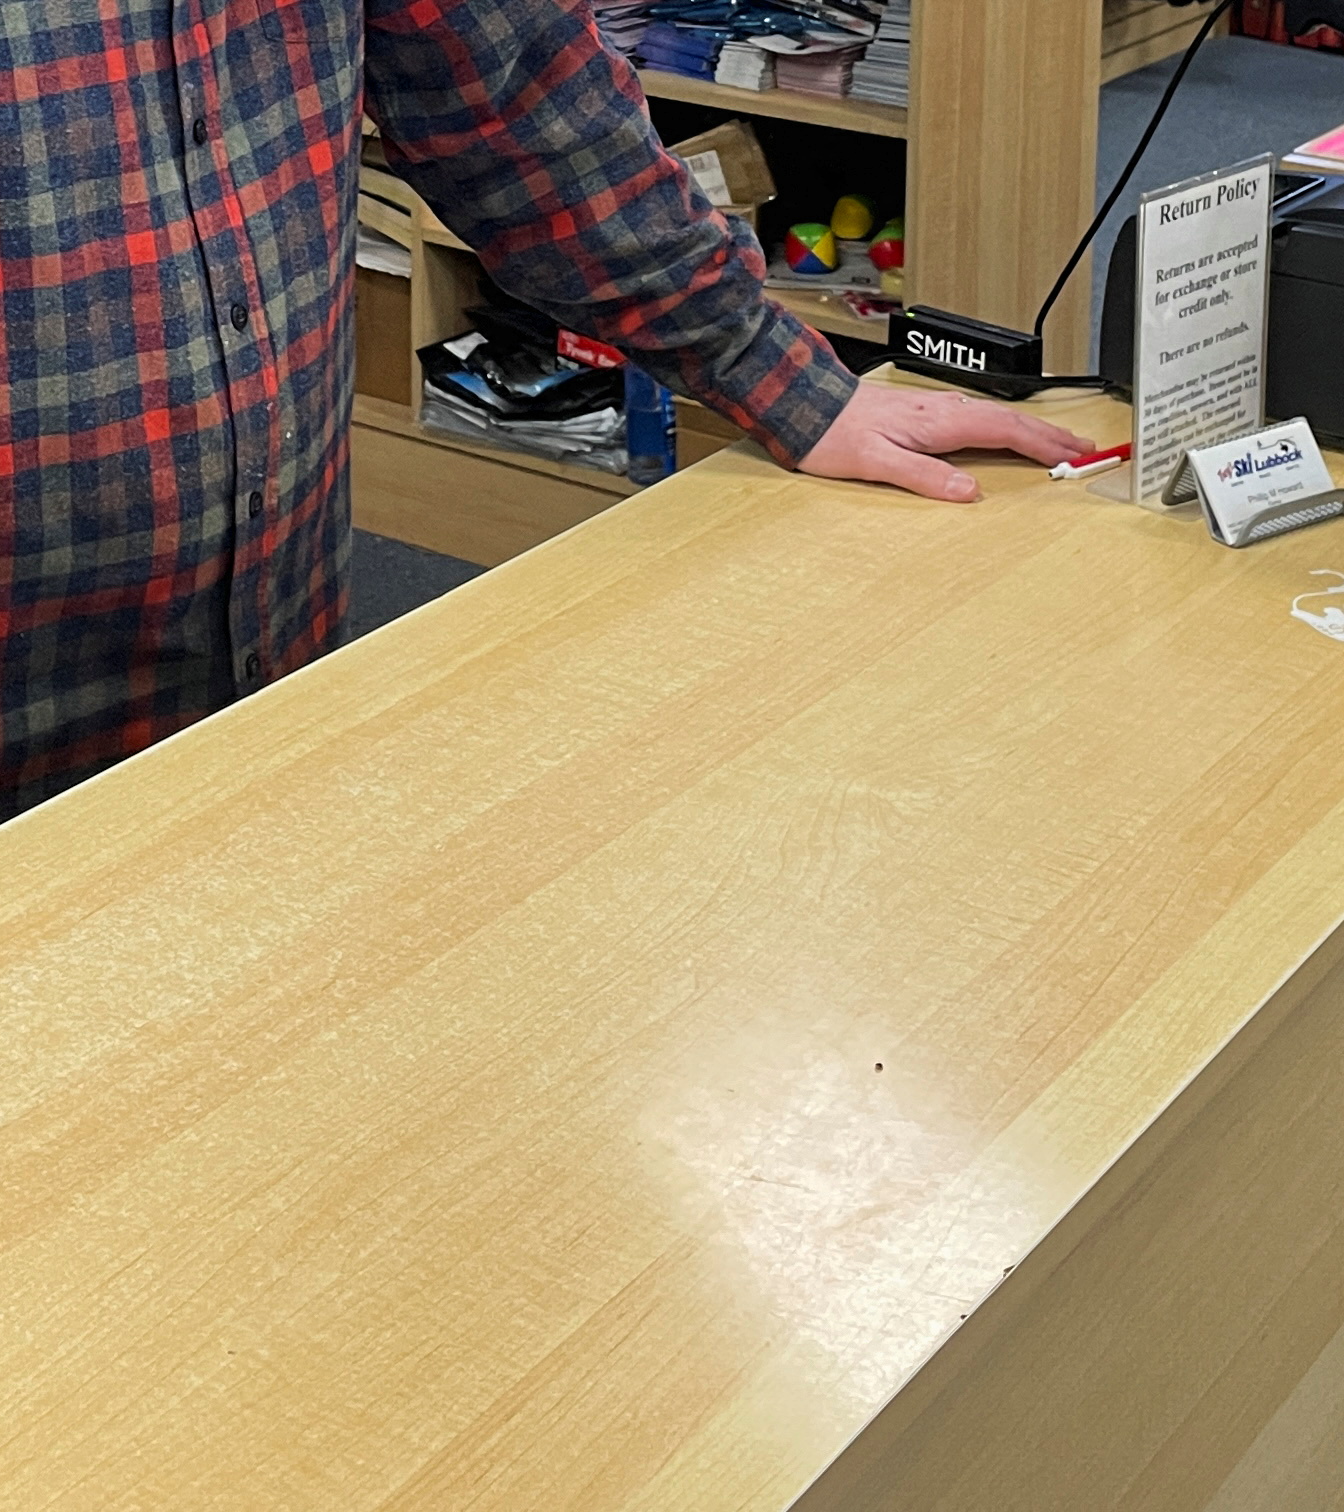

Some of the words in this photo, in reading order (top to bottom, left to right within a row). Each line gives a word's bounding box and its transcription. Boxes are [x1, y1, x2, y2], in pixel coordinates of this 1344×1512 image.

[1159, 193, 1212, 226] Return
[1216, 177, 1261, 207] Policy
[1155, 260, 1196, 285] Returns
[1197, 253, 1214, 269] are
[1216, 233, 1259, 262] accepted
[1155, 290, 1170, 307] for
[1172, 273, 1218, 300] exchange
[1219, 269, 1231, 283] or
[1233, 259, 1258, 278] store
[1178, 297, 1208, 319] credit
[906, 330, 986, 371] SMITH
[1158, 345, 1185, 366] There
[1186, 339, 1201, 355] are
[1202, 334, 1214, 348] no
[1253, 448, 1304, 472] Lubbock
